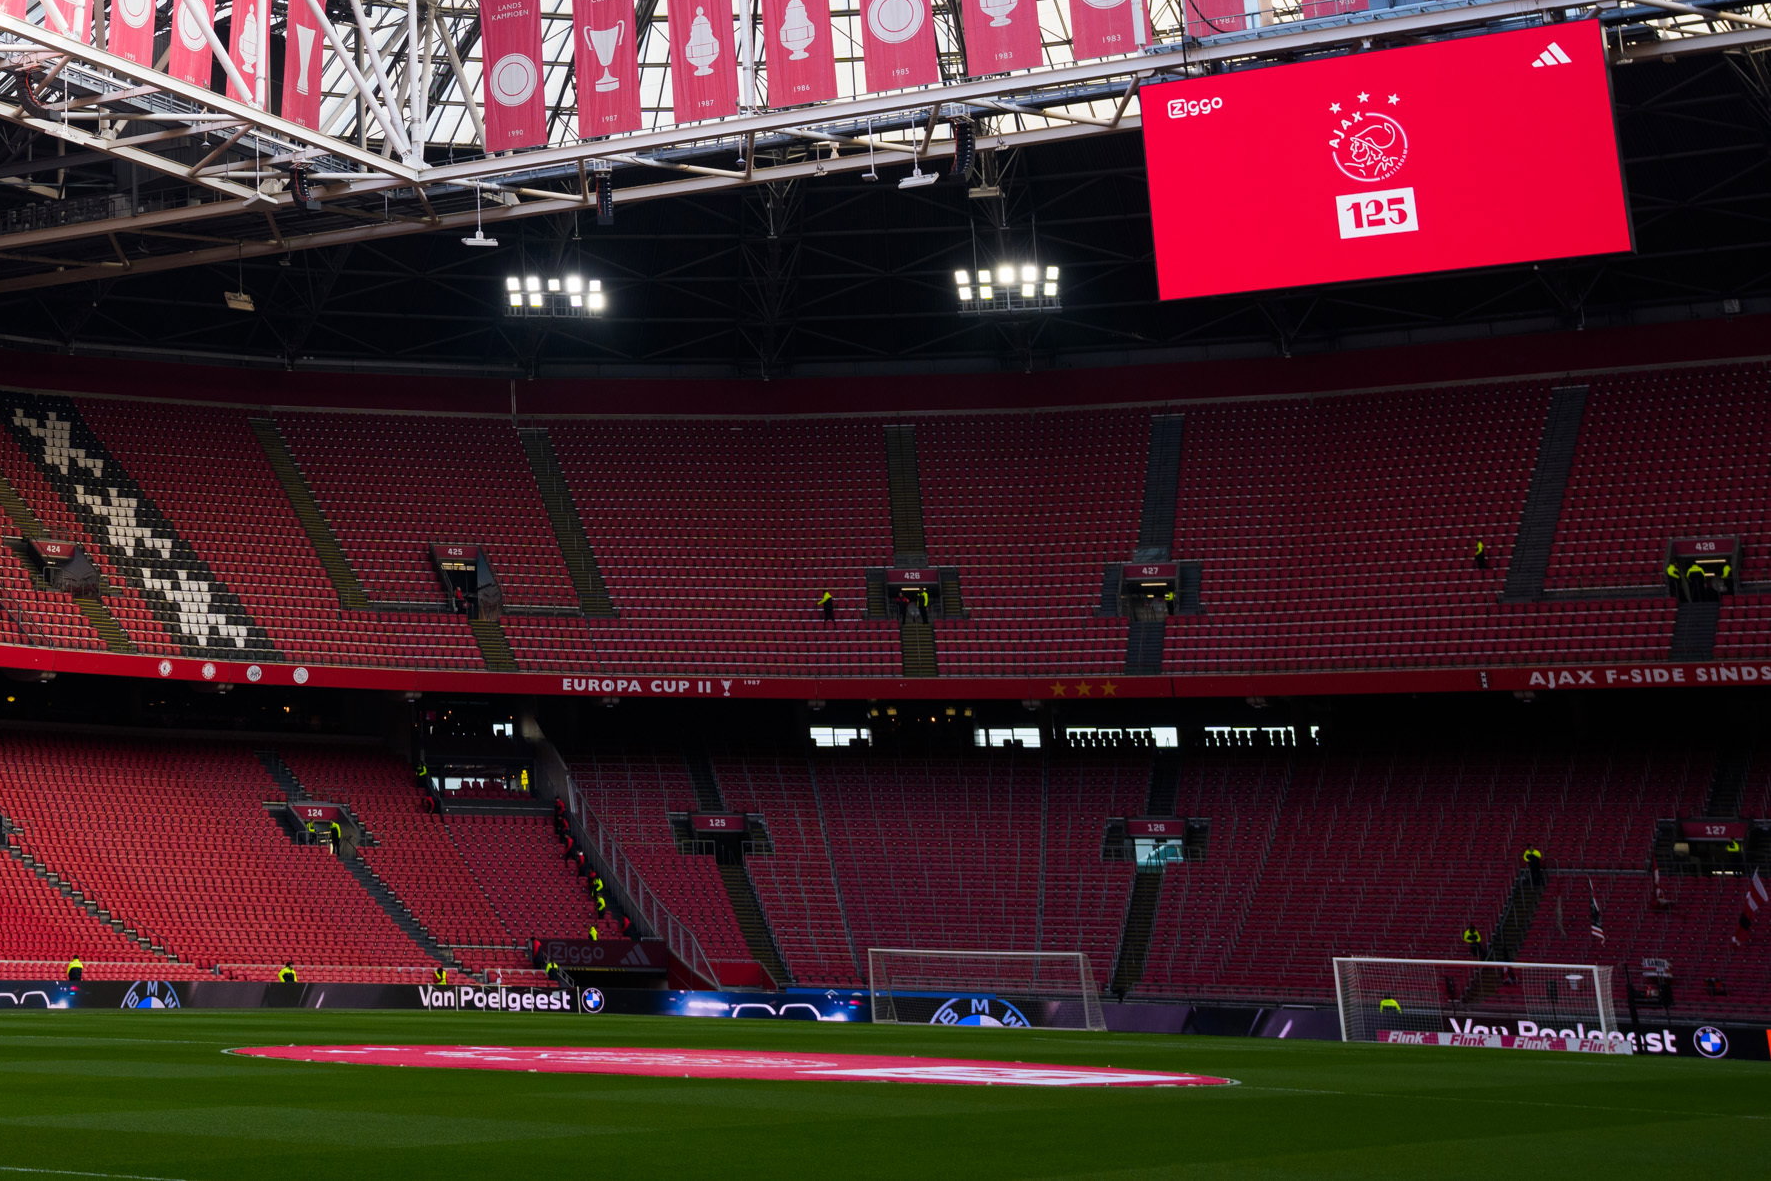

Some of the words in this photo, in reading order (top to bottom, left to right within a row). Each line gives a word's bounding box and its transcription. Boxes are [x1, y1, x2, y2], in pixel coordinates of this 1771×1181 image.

[497, 1, 522, 12] LANDS
[491, 9, 529, 21] KAMPIOEN
[1102, 35, 1121, 43] 1983
[995, 52, 1013, 60] 1983
[892, 67, 909, 76] 1985
[793, 84, 810, 92] 1986
[697, 99, 714, 107] 1987
[1167, 97, 1223, 119] Ziggo
[601, 114, 617, 123] 1987
[507, 129, 523, 137] 1990
[1329, 111, 1363, 148] AJAX
[1346, 196, 1408, 229] 125
[46, 545, 60, 553] 424
[1695, 541, 1716, 551] 428
[1141, 567, 1158, 575] 427
[1528, 670, 1596, 689] AJAX
[1606, 667, 1686, 684] F-SIDE
[1695, 665, 1771, 682] SINDS
[562, 678, 642, 692] EUROPA
[650, 679, 690, 692] CUP
[698, 680, 711, 693] II
[307, 808, 322, 817] 124
[709, 818, 726, 827] 125
[1147, 823, 1165, 832] 126
[1705, 825, 1726, 835] 127
[547, 942, 604, 964] Ziggo
[418, 986, 455, 1007] Van
[460, 986, 571, 1011] Poelgeest
[1449, 1034, 1486, 1047] Flink
